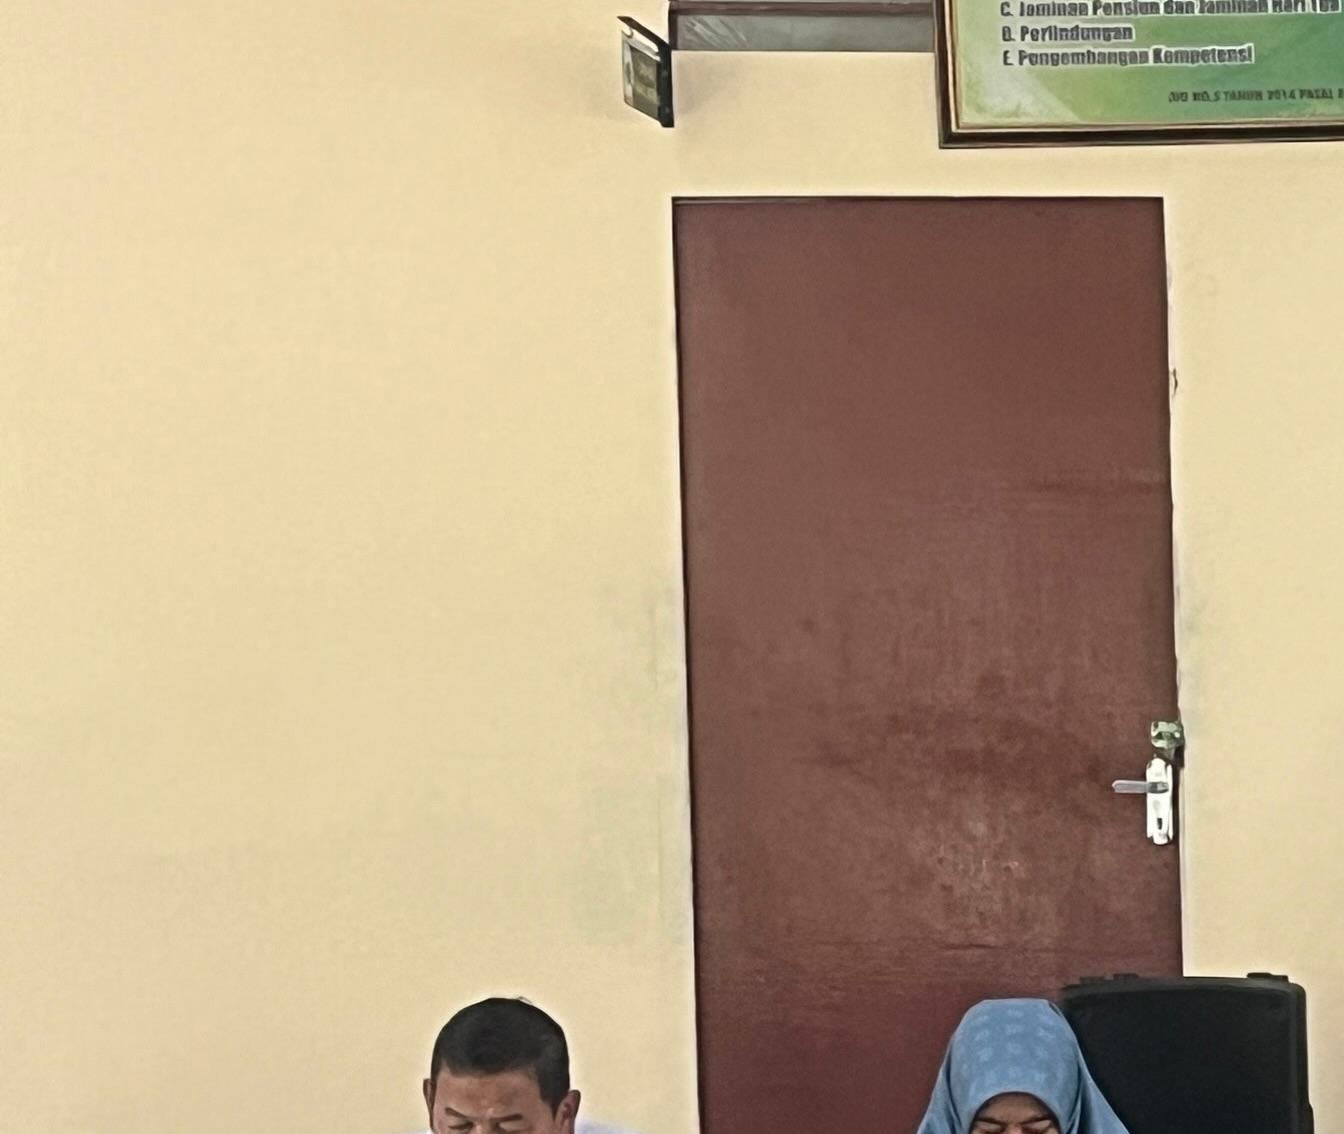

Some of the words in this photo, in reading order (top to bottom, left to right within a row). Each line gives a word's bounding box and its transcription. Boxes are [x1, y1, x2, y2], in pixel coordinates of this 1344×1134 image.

[1021, 25, 1134, 42] Perlindungan
[1019, 49, 1150, 67] Pengembangan
[1152, 46, 1254, 66] Kompetensi
